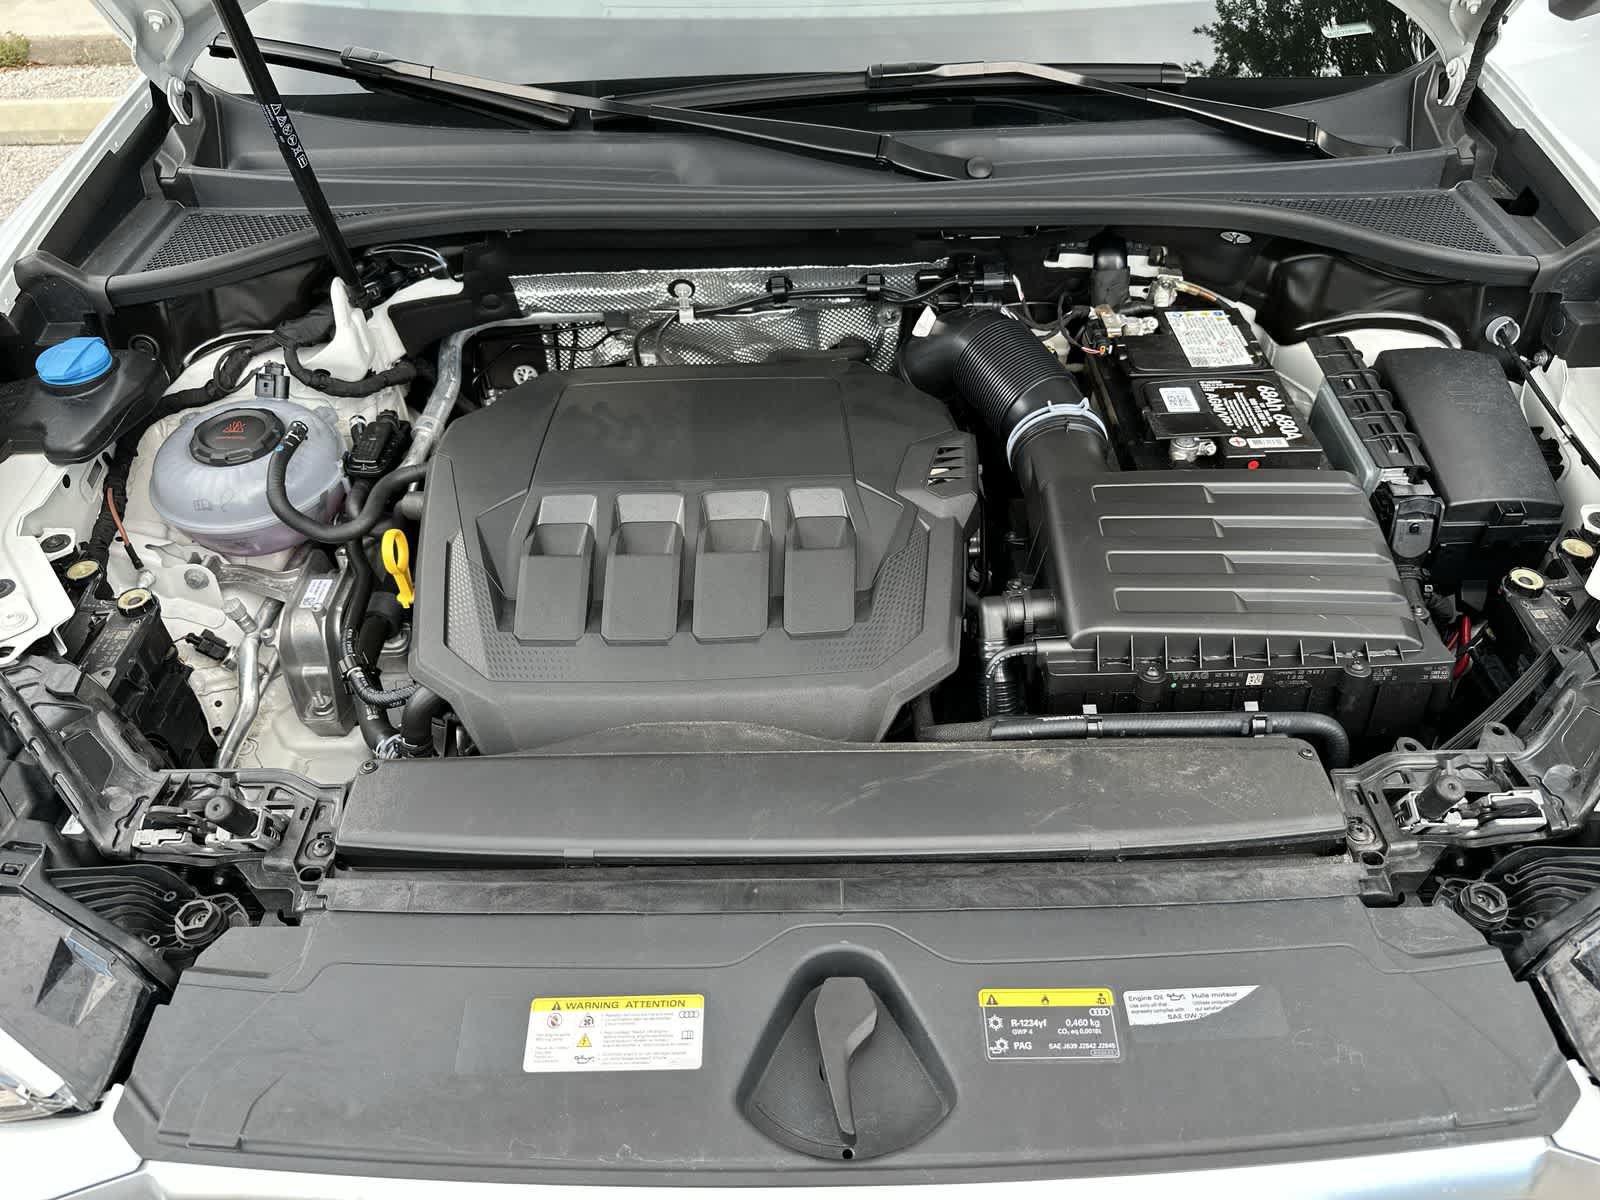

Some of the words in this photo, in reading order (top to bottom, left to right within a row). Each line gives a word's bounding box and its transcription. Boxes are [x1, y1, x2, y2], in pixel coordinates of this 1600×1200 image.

[1257, 385, 1285, 411] 68Ah
[1272, 413, 1304, 440] 680A
[1128, 994, 1152, 1003] Engine
[566, 1000, 619, 1010] WARNING
[625, 999, 686, 1009] ATTENTION
[1010, 1018, 1047, 1029] R-1234yf
[1065, 1018, 1088, 1027] 0,460
[1089, 1018, 1100, 1028] kg
[1013, 1041, 1033, 1050] PAG
[1048, 1042, 1062, 1050] SAE
